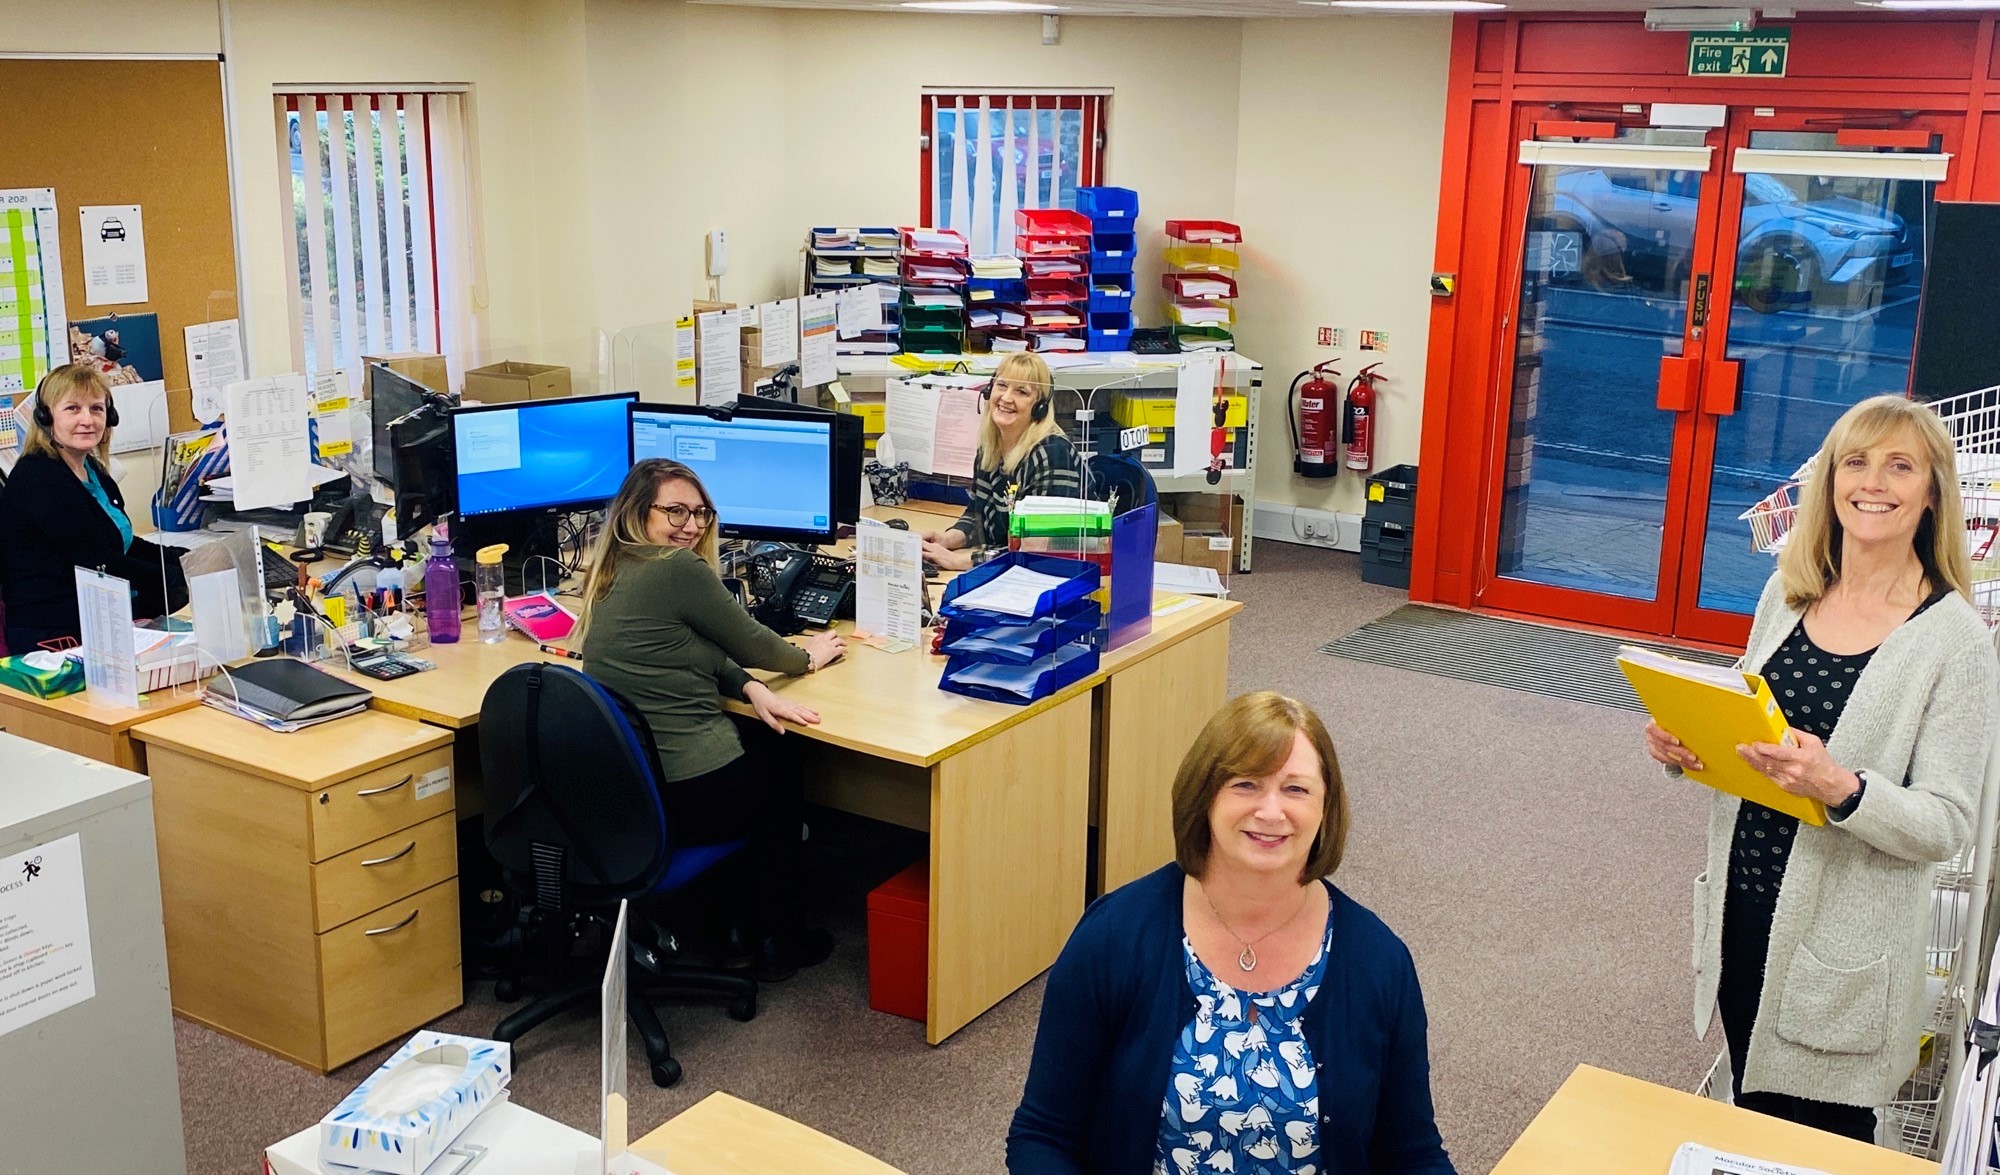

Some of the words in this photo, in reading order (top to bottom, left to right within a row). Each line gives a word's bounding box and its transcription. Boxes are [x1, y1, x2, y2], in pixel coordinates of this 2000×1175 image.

[1698, 46, 1722, 58] Fire
[1697, 60, 1721, 72] exit
[8, 195, 28, 204] 2021
[1694, 280, 1707, 321] PUSH
[1714, 1156, 1756, 1169] Macular
